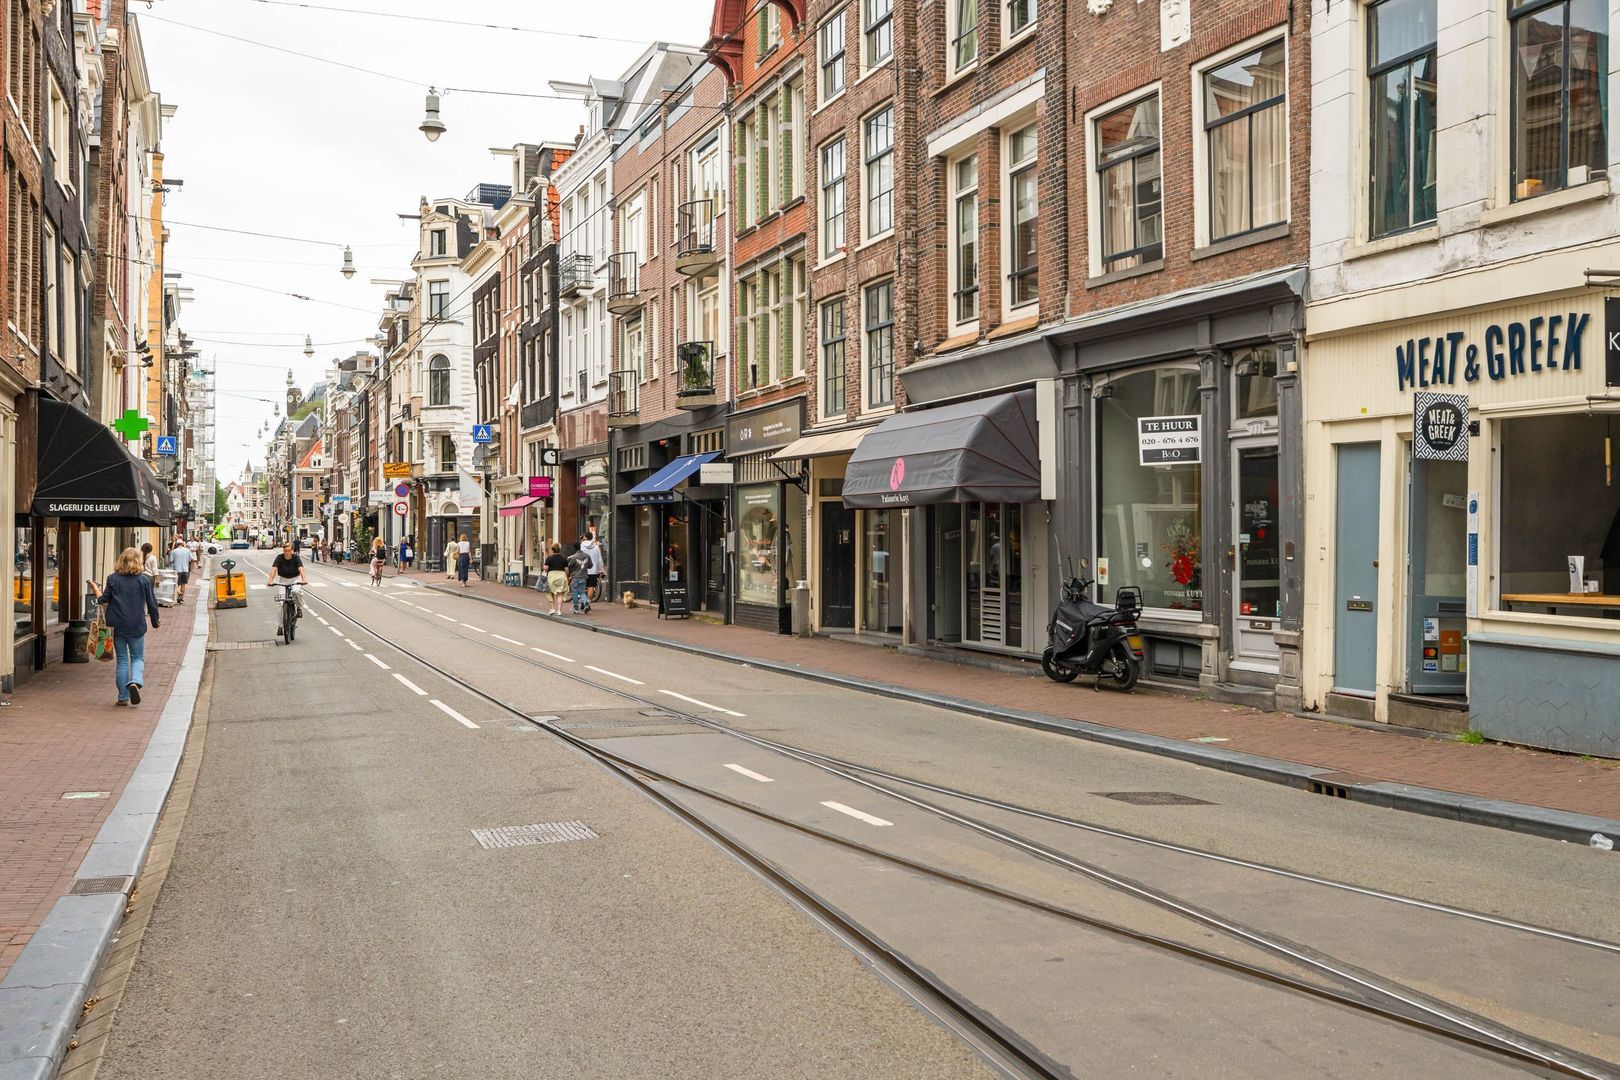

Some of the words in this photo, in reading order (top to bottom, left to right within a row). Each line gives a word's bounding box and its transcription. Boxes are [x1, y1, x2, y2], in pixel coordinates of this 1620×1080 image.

[1146, 422, 1160, 431] TE
[1162, 420, 1193, 430] HUUR
[1428, 425, 1456, 441] GREEK
[1185, 435, 1199, 443] 676
[49, 503, 83, 512] SLAGERIJ
[84, 504, 94, 512] DE
[95, 504, 120, 512] LEEUW
